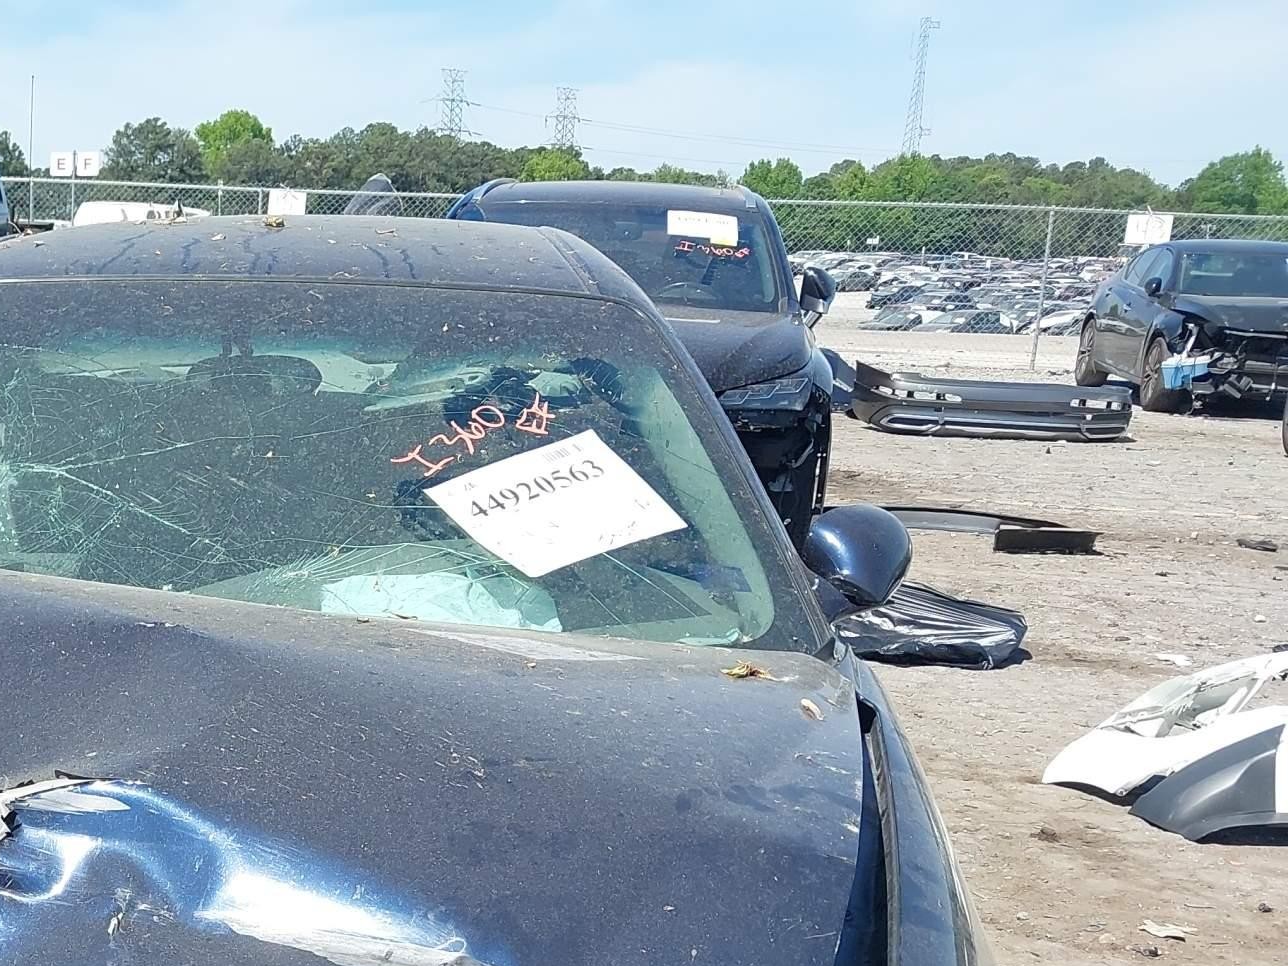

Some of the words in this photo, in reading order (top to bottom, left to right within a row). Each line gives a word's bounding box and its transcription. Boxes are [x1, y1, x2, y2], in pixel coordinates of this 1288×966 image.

[57, 158, 66, 170] E
[83, 158, 92, 170] F
[471, 459, 605, 518] 44920563
